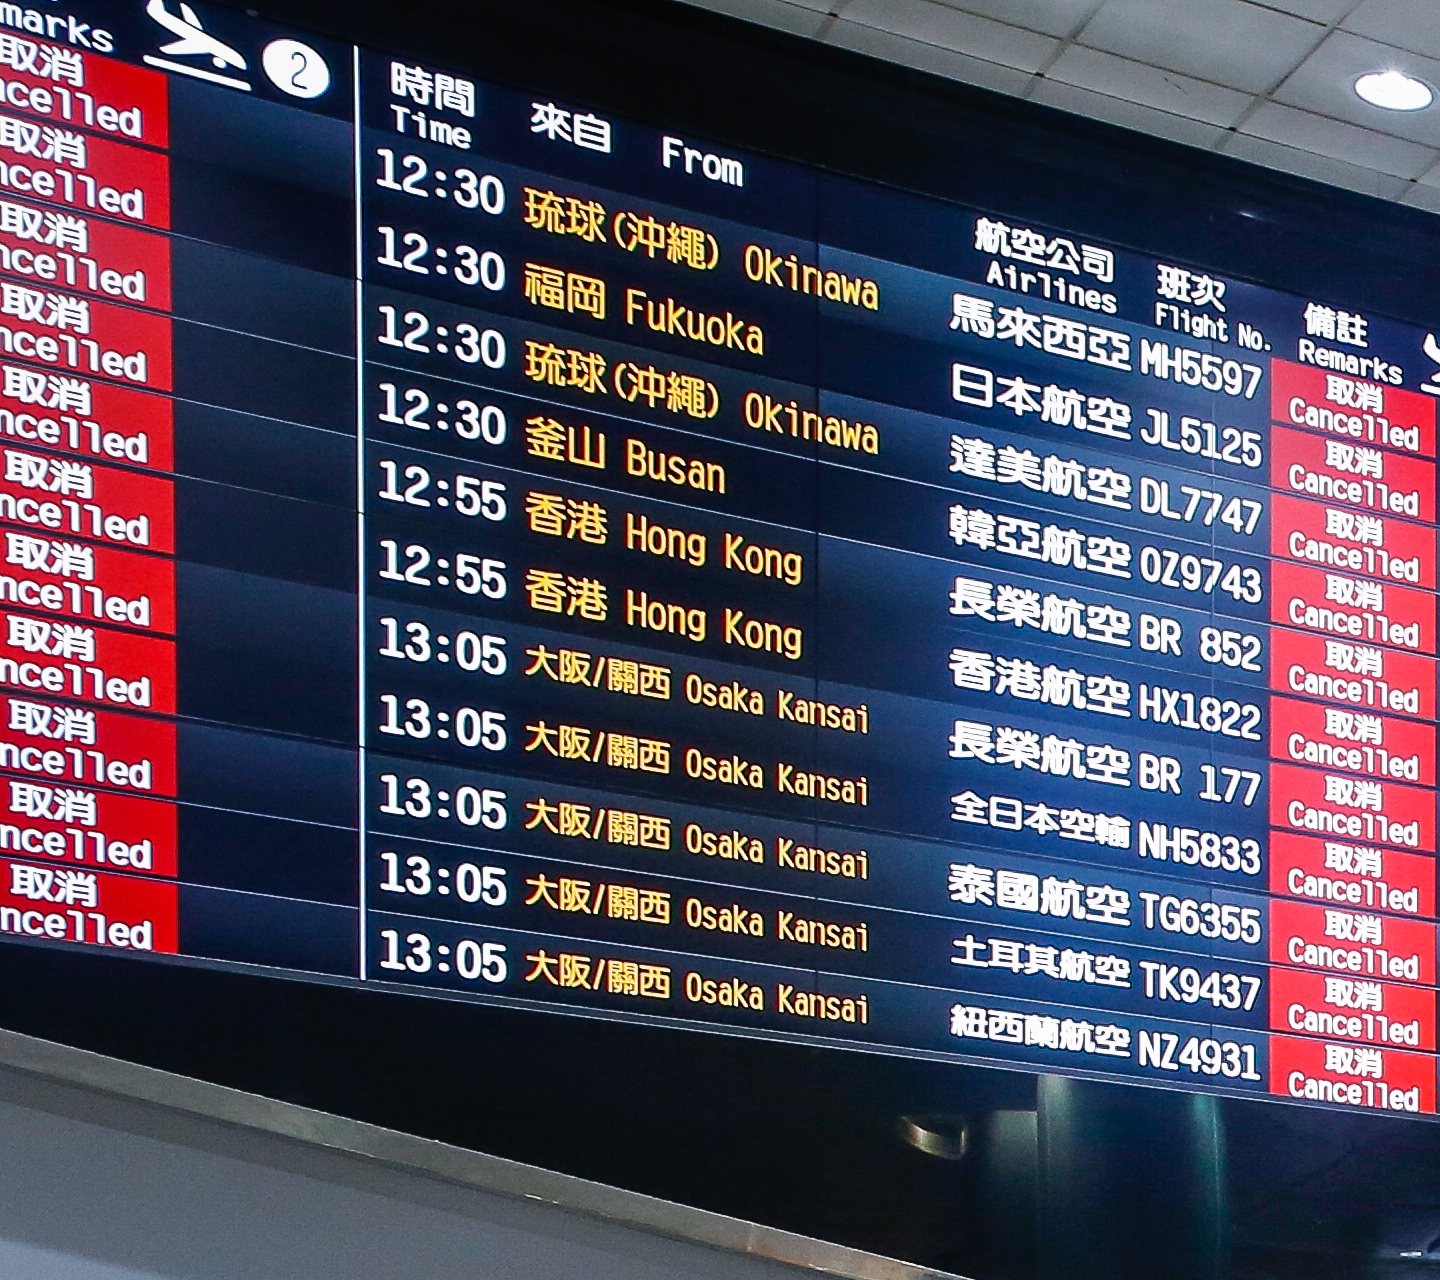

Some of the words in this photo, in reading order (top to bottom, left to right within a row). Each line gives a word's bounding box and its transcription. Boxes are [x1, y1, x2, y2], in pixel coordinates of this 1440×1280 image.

[0, 35, 83, 87] 取消
[290, 51, 309, 90] 2
[377, 149, 505, 214] 12:30
[524, 188, 718, 275] 琉球(沖繩)
[746, 246, 878, 310] Okinawa
[950, 292, 1131, 371] 馬來西亞
[1142, 339, 1261, 398] MH5597
[1326, 375, 1382, 413] 取消
[391, 62, 475, 117] 時間
[531, 103, 611, 153] 來自
[663, 137, 743, 187] From
[975, 218, 1113, 286] 航空公司
[1157, 265, 1225, 312] 班次
[1304, 303, 1367, 347] 備註
[391, 104, 471, 149] Time
[987, 259, 1117, 313] Airlines
[1156, 302, 1228, 342] Flight
[1239, 323, 1270, 350] No.
[1299, 339, 1402, 384] Remarks
[378, 227, 505, 290] 12:30
[525, 263, 605, 319] 福岡
[628, 290, 763, 355] Fukuoka
[953, 364, 1131, 439] 日本航空
[1141, 409, 1261, 467] JL5125
[379, 306, 505, 370] 12:30
[522, 341, 718, 418] 琉球(沖繩)
[746, 393, 878, 458] Okinawa
[946, 435, 1131, 514] 達美航空
[1141, 474, 1261, 534] DL7747
[1290, 397, 1418, 451] Cancelled
[379, 381, 506, 446] 12:30
[526, 417, 605, 468] 釜山
[628, 440, 725, 493] Busan
[946, 501, 1133, 578] 韓亞航空
[1141, 545, 1264, 602] OZ9743
[379, 461, 506, 520] 12:55
[526, 492, 608, 544] 香港
[628, 513, 706, 566] Hong
[726, 534, 802, 585] Kong
[950, 574, 1133, 646] 長榮航空
[1141, 615, 1181, 655] BR
[1201, 628, 1261, 671] 852
[1326, 641, 1383, 677] 取消
[379, 541, 506, 598] 12:55
[526, 570, 607, 620] 香港
[628, 590, 706, 641] Hong
[726, 609, 801, 659] Kong
[949, 649, 1130, 717] 香港航空
[1140, 685, 1260, 740] HX1822
[380, 618, 506, 675] 13:05
[526, 645, 671, 699] 大阪/關西
[687, 675, 763, 715] Osaka
[779, 690, 867, 733] Kansai
[949, 721, 1130, 786] 長榮航空
[1140, 754, 1180, 794] BR
[1200, 765, 1260, 805] 177
[1290, 666, 1418, 713] Cancelled
[0, 898, 153, 950] ncelled
[10, 864, 98, 907] 取消
[380, 853, 506, 905] 13:05
[526, 874, 670, 924] 大阪/關西
[687, 899, 763, 936] Osaka
[779, 911, 866, 951] Kansai
[951, 935, 1130, 987] 土耳其航空
[1139, 962, 1260, 1010] TK9437
[381, 775, 506, 829] 13:05
[526, 799, 671, 849] 大阪/關西
[687, 825, 763, 863] Osaka
[779, 838, 867, 879] Kansai
[949, 864, 1130, 926] 泰國航空
[1140, 893, 1260, 943] TG6355
[381, 930, 506, 984] 13:05
[526, 950, 670, 998] 大阪/關西
[687, 973, 763, 1010] Osaka
[779, 984, 866, 1023] Kansai
[951, 1005, 1130, 1056] 紐西蘭航空
[1140, 1031, 1260, 1082] NZ4931
[1325, 1045, 1382, 1078] 取消
[1286, 1072, 1418, 1112] Cancelled
